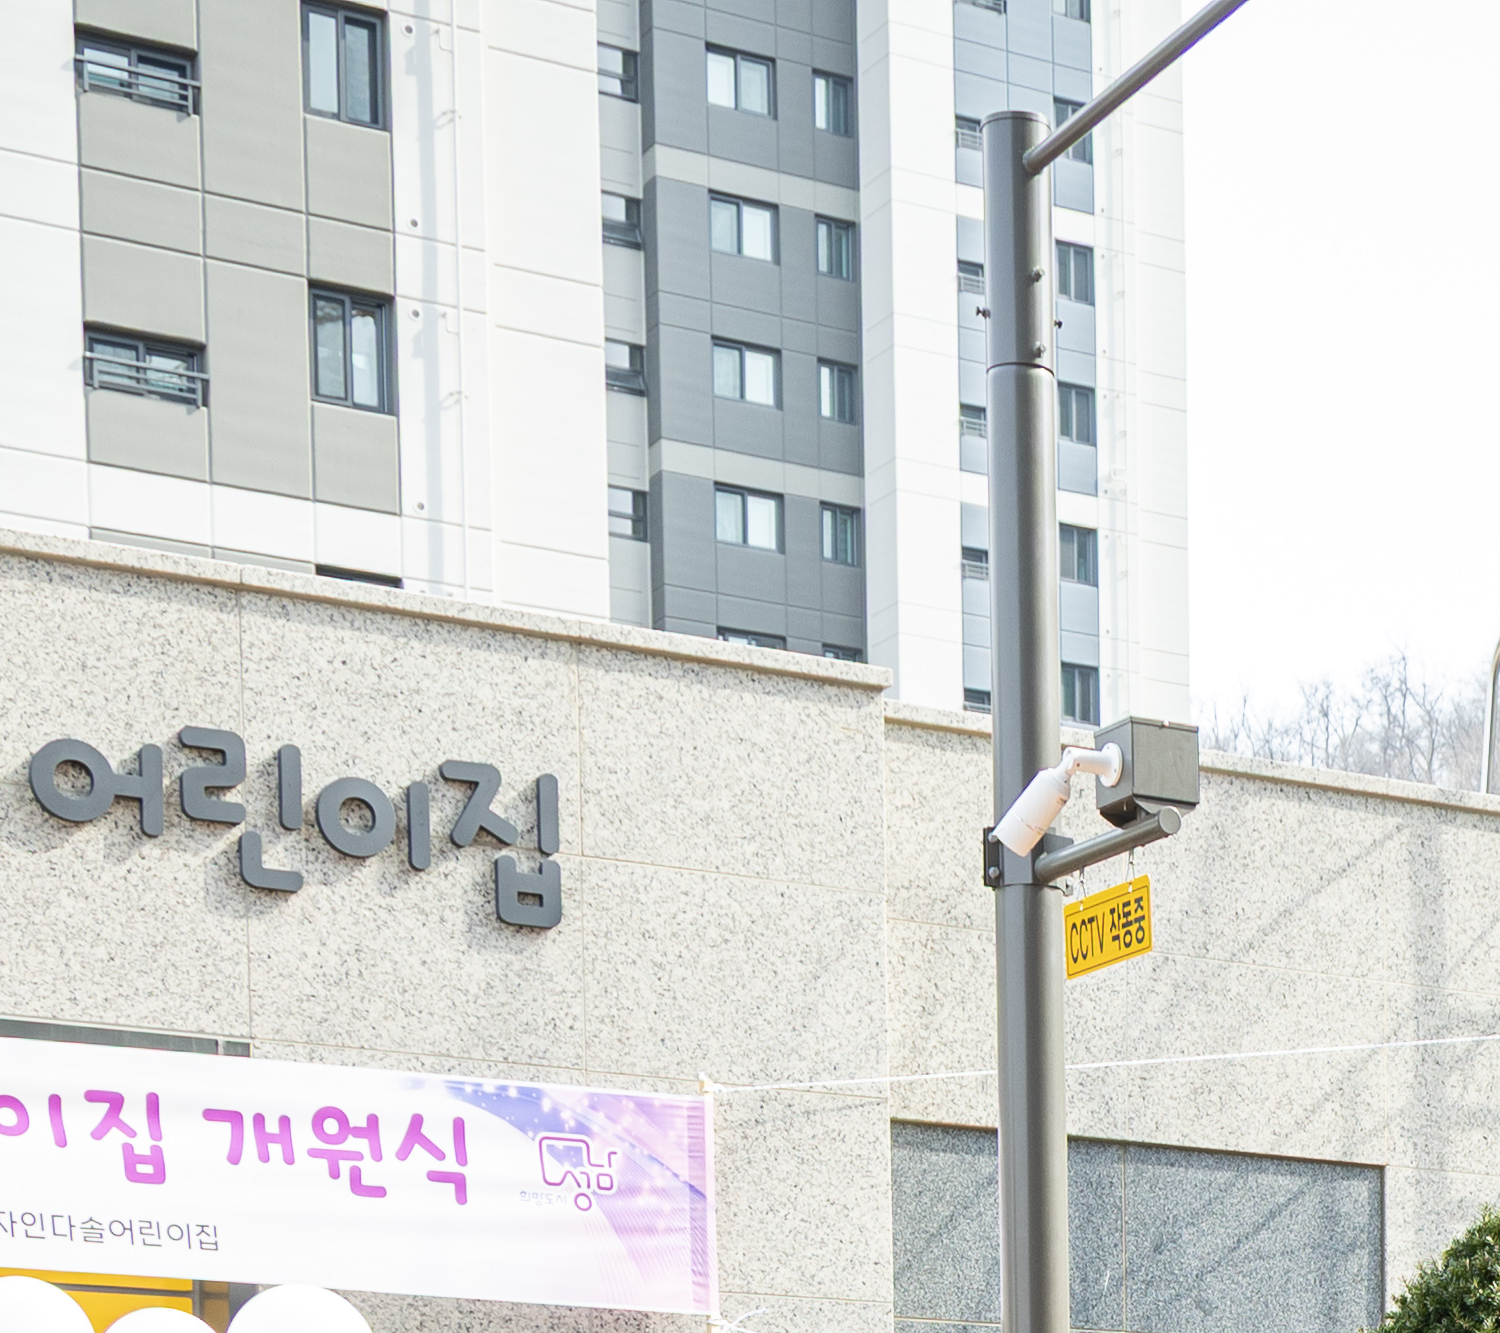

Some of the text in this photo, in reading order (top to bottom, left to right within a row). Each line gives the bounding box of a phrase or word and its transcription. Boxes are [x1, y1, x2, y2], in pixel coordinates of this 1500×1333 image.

[29, 725, 563, 930] 어린이집
[1069, 895, 1147, 965] CCTV 작동중
[203, 1103, 471, 1207] 개원식
